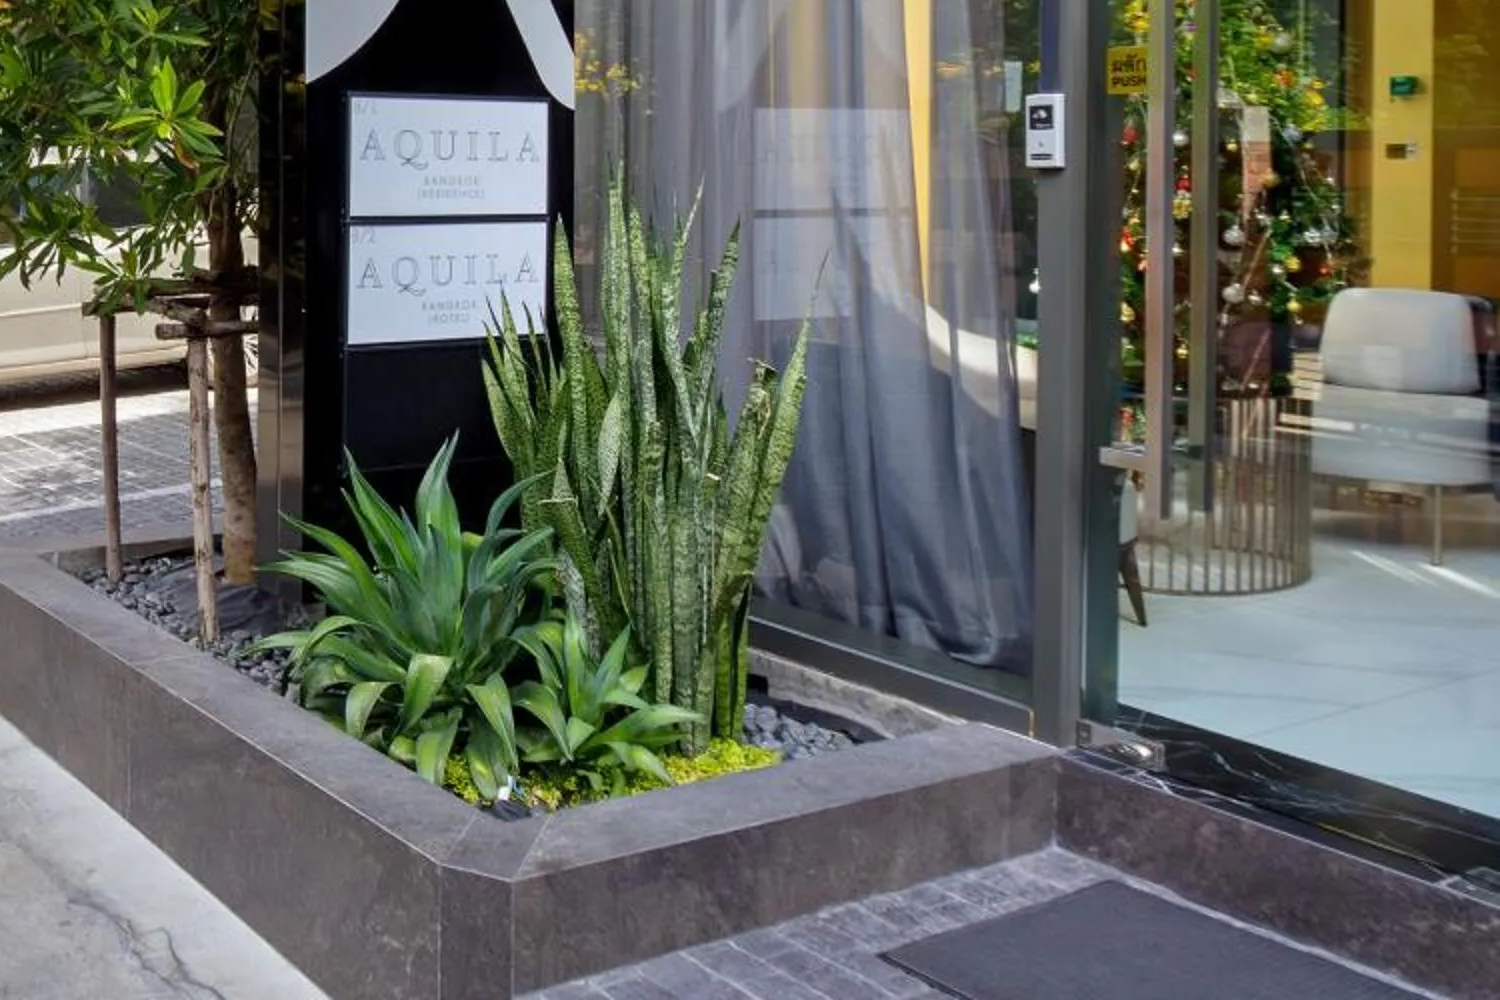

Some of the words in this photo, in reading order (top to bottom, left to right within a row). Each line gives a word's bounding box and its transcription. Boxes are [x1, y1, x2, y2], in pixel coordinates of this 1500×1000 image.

[1112, 76, 1147, 87] PUSH
[359, 127, 540, 171] AQUILA
[423, 175, 480, 187] BANGKOK
[356, 251, 540, 297] AQUILA
[421, 299, 477, 311] BANGKOK
